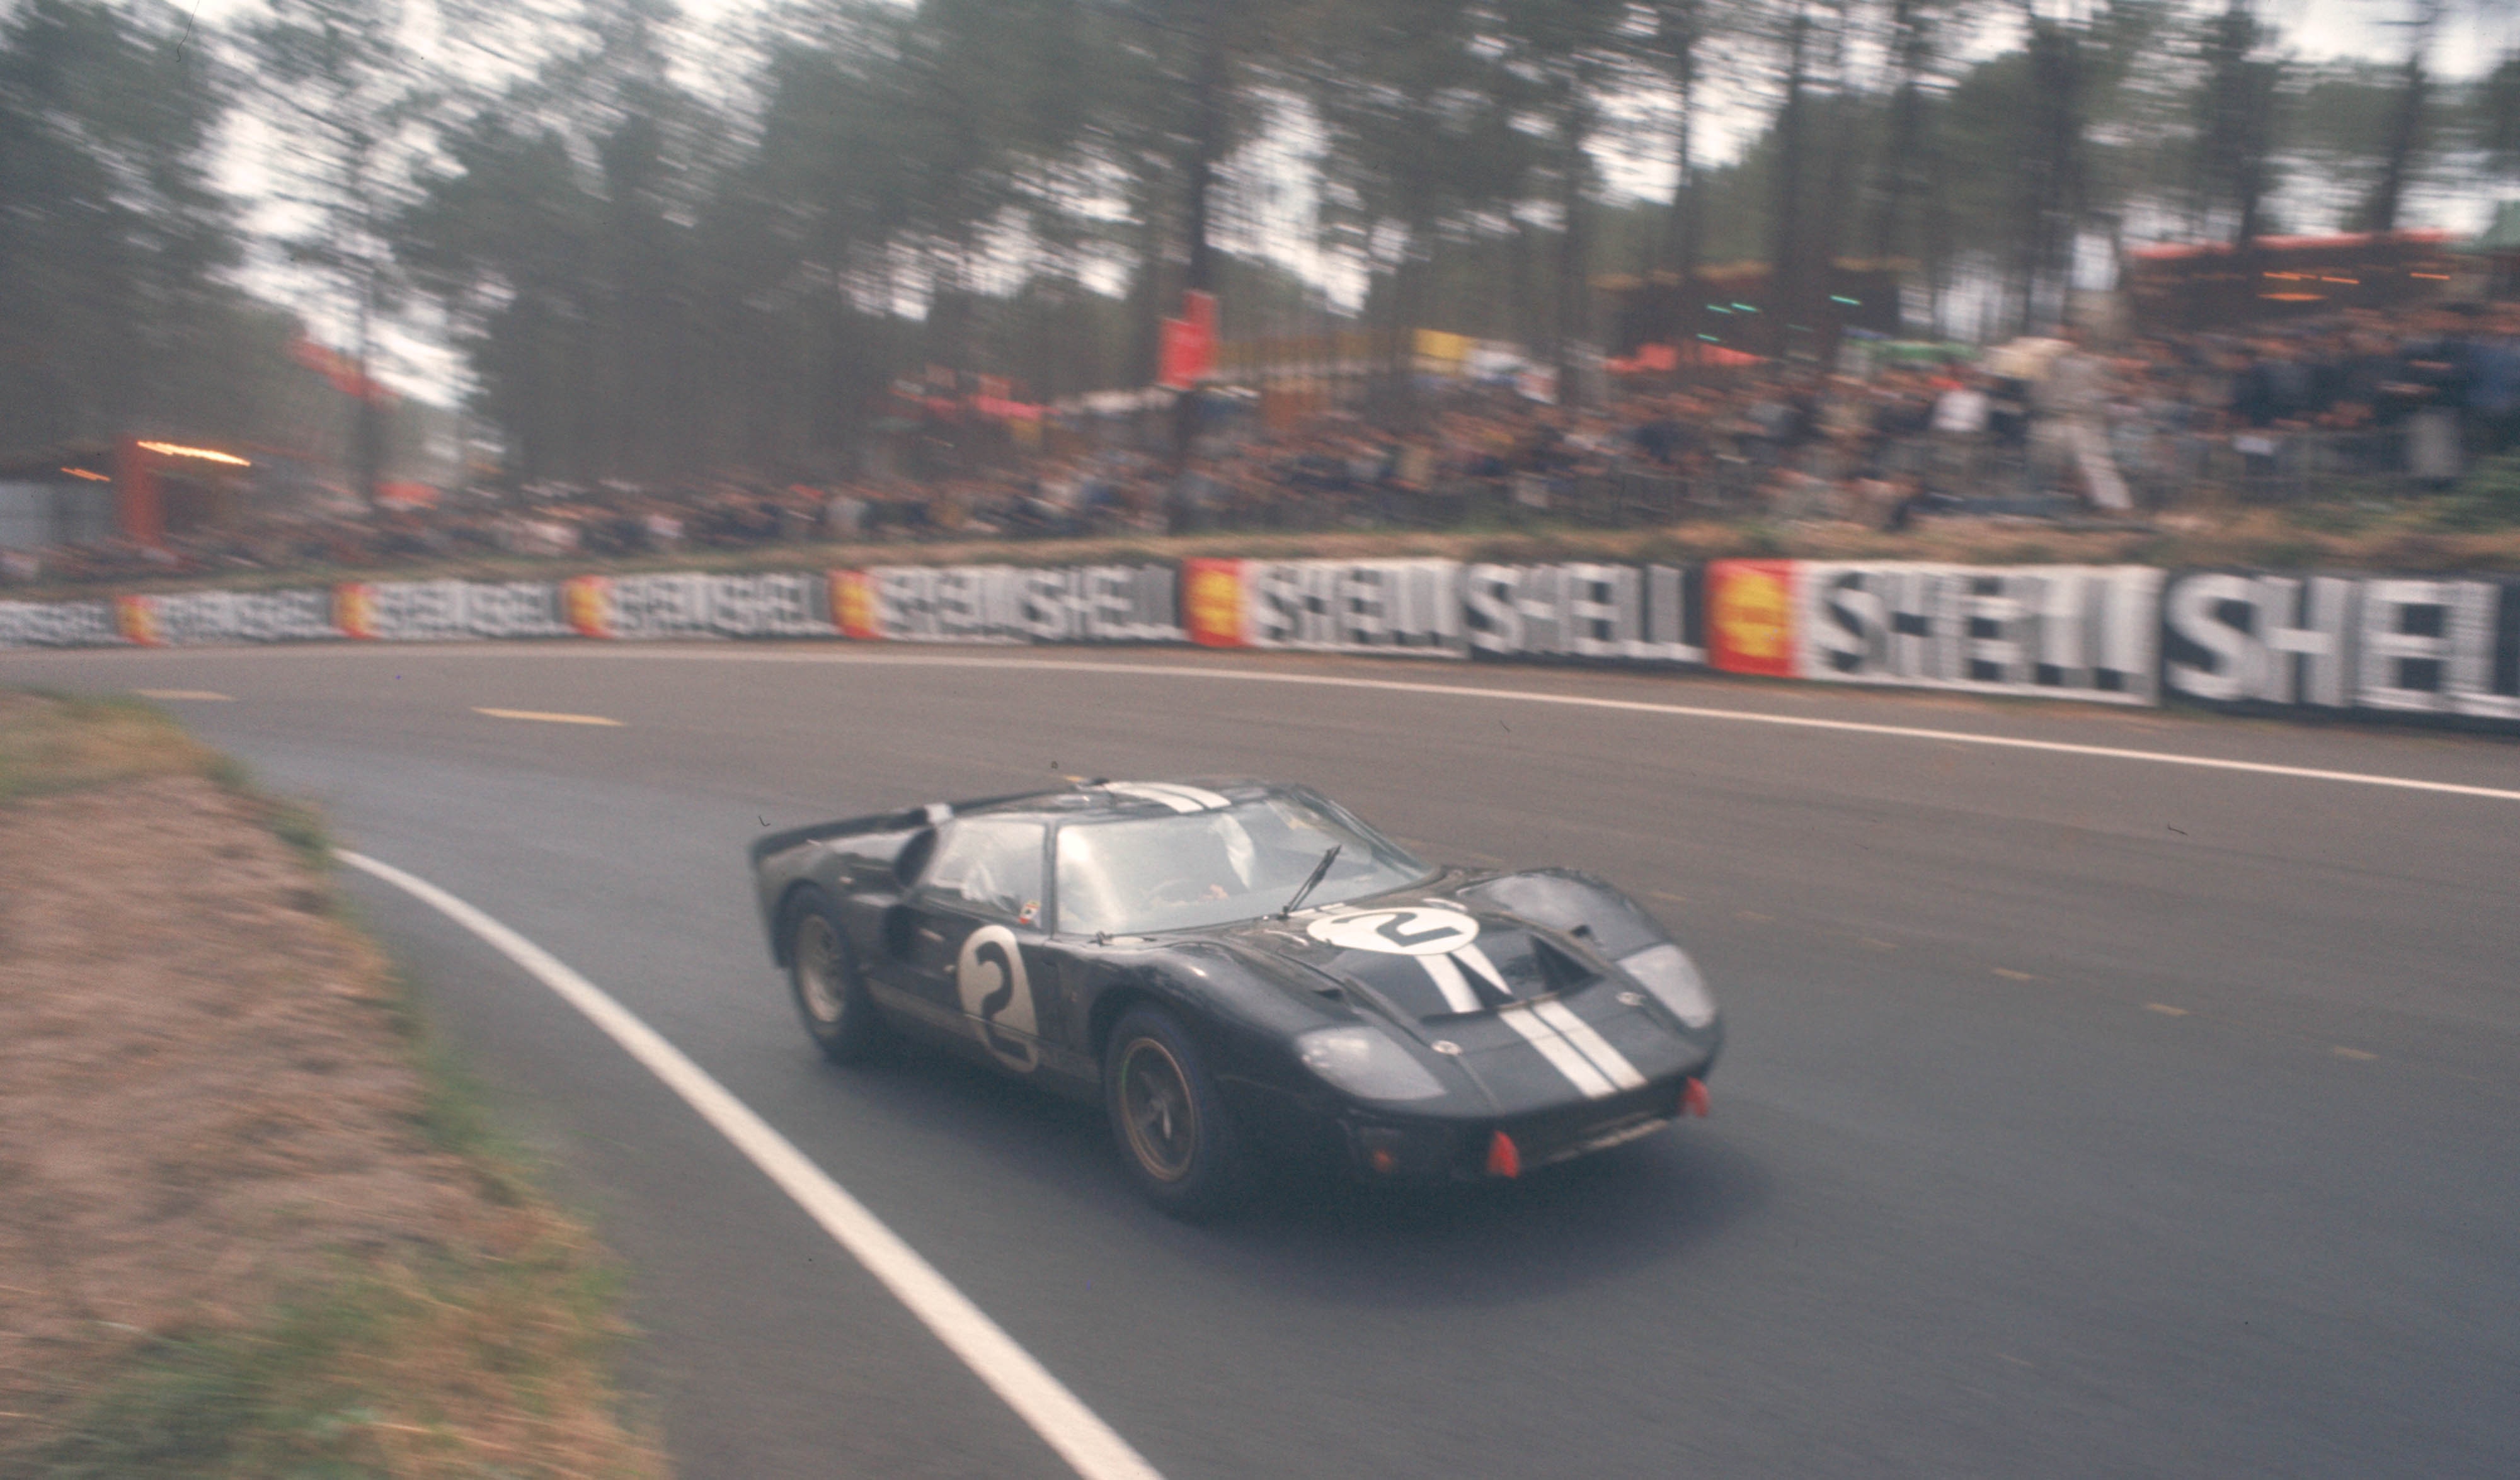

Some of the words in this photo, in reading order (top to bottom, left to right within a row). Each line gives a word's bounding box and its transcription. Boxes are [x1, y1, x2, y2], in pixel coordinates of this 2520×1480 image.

[1818, 569, 2158, 693] SHELL
[1330, 911, 1463, 948] 2
[975, 940, 1030, 1062] 2
